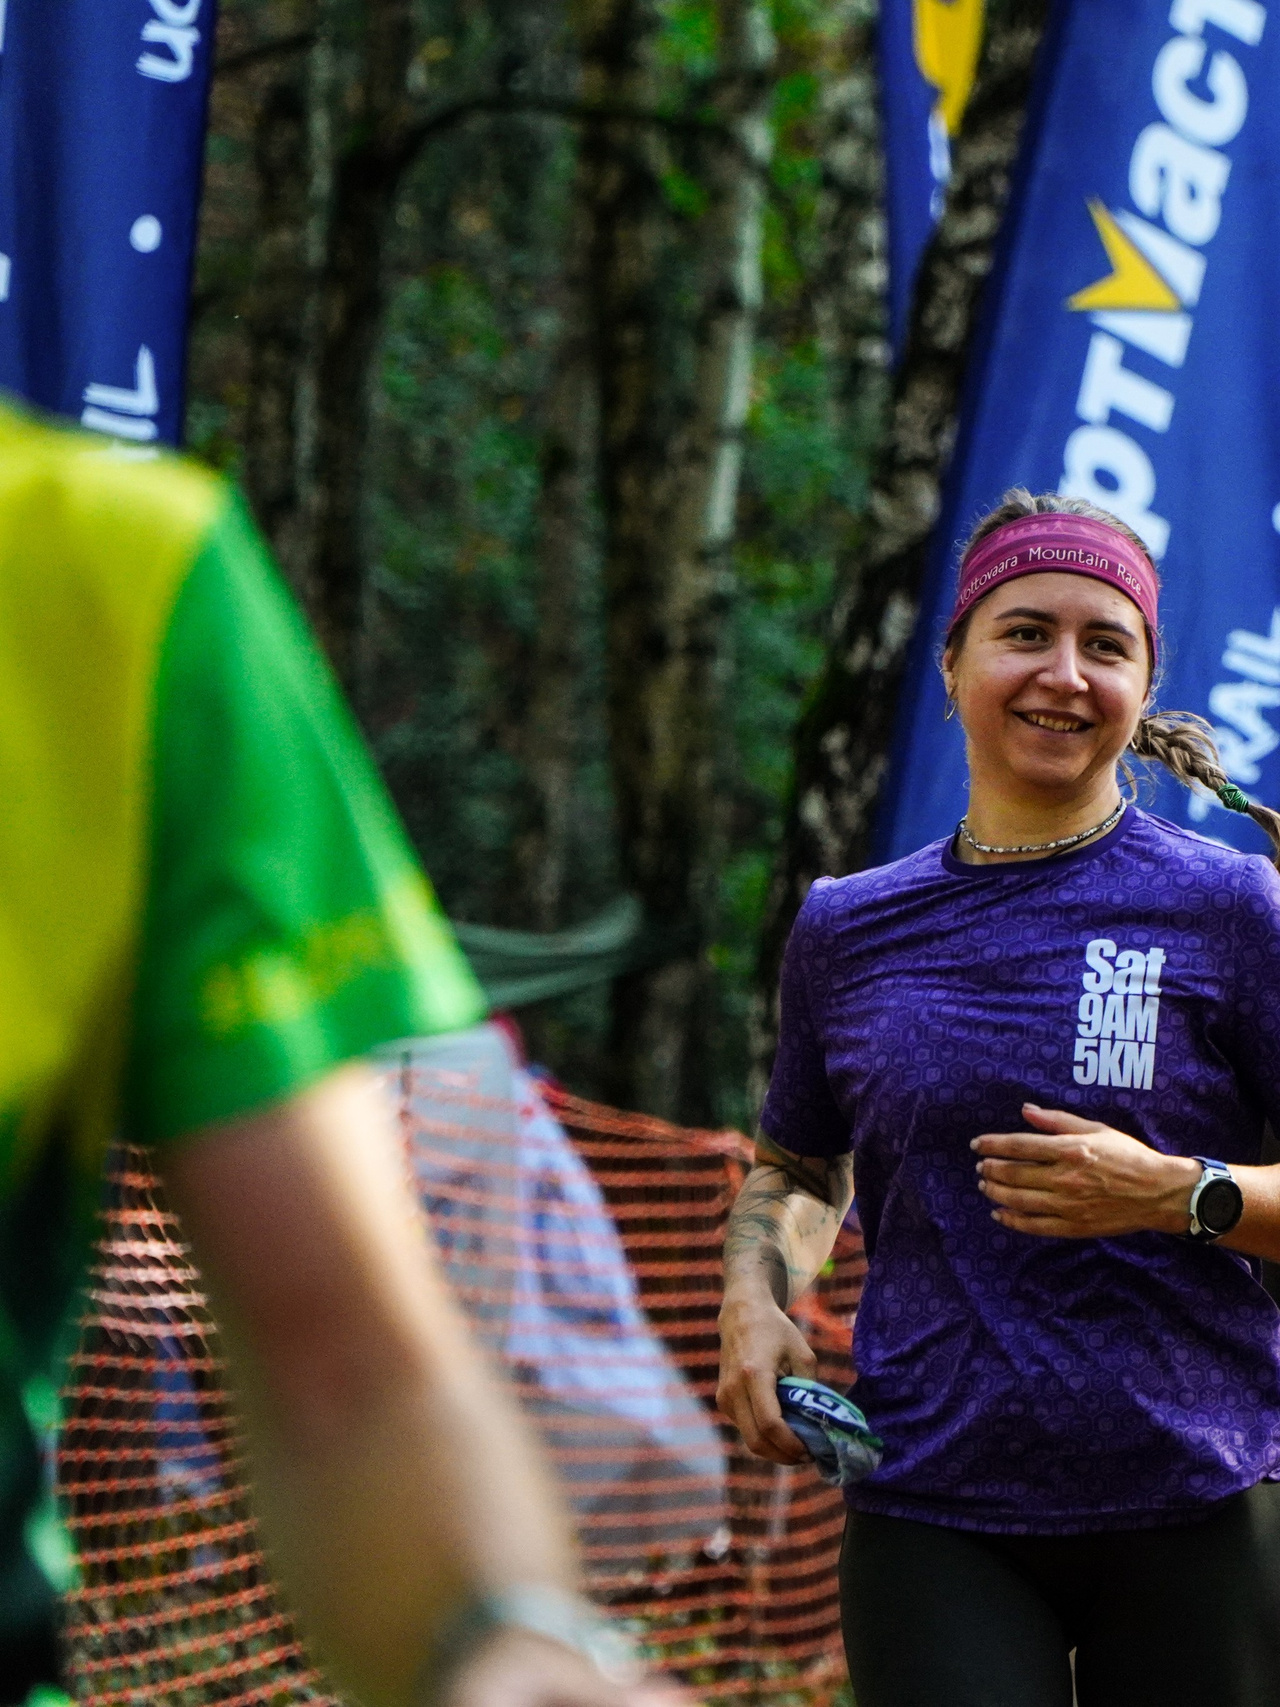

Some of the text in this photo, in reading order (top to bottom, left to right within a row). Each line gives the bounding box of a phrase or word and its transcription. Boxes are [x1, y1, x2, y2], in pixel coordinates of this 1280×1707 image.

[1028, 547, 1109, 570] Mountain
[1117, 563, 1142, 596] Race
[1082, 938, 1167, 996] Sat
[1077, 992, 1160, 1043] 9AM
[1073, 1038, 1156, 1091] 5KM
